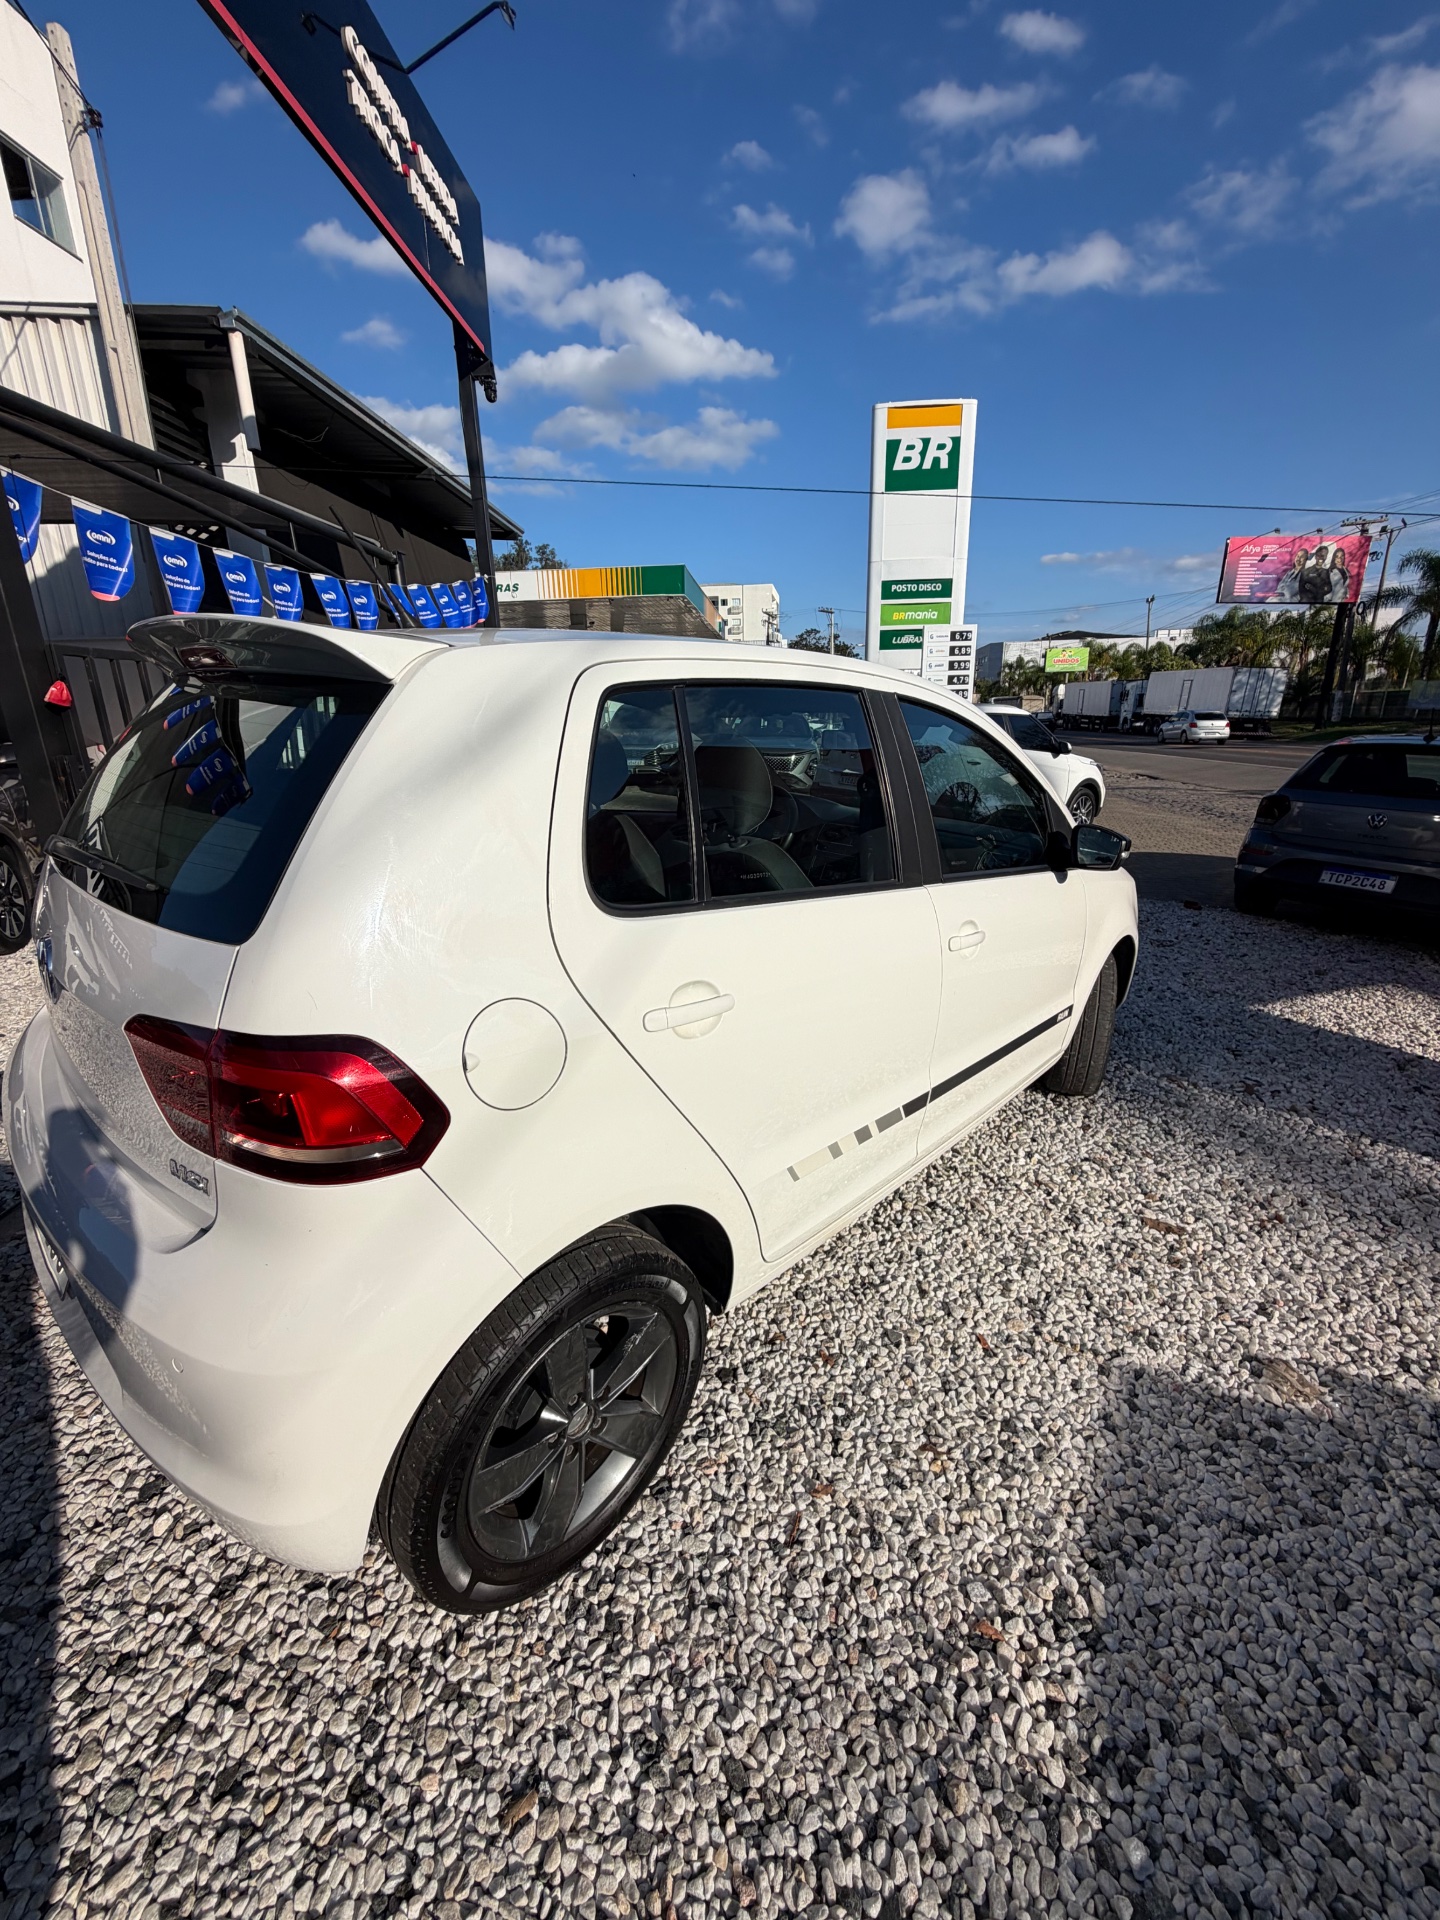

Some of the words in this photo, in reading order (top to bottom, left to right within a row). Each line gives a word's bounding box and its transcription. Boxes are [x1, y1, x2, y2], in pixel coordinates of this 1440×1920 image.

[893, 436, 953, 471] BR
[90, 531, 112, 545] omni
[1240, 545, 1261, 554] Afya
[891, 584, 917, 592] POSTO
[918, 583, 942, 592] DISCO
[892, 609, 938, 620] BRmania
[955, 632, 972, 640] 6,79
[954, 647, 971, 656] 6,89
[953, 662, 970, 670] 9,99
[952, 676, 969, 684] 4,79
[1328, 872, 1387, 890] TCP2C48
